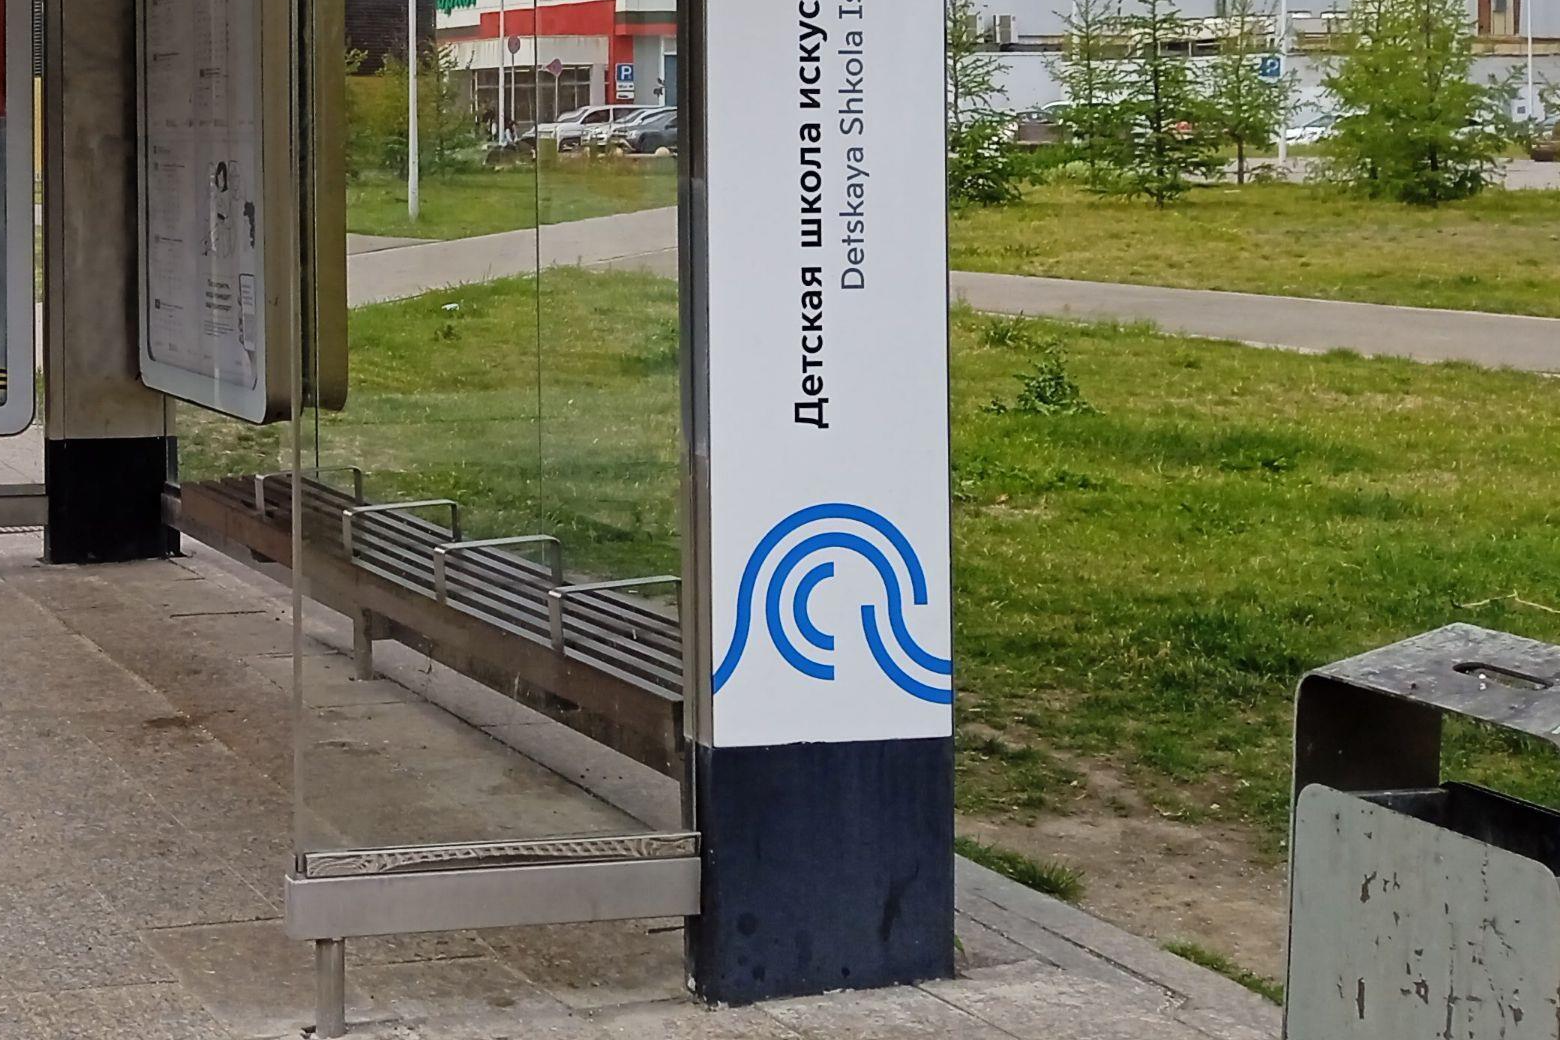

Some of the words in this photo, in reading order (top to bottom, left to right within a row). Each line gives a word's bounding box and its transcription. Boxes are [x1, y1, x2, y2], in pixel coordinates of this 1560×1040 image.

[838, 31, 864, 135] Shkola
[800, 123, 822, 247] школа
[839, 147, 870, 289] Detskaya
[794, 267, 829, 429] Детская
